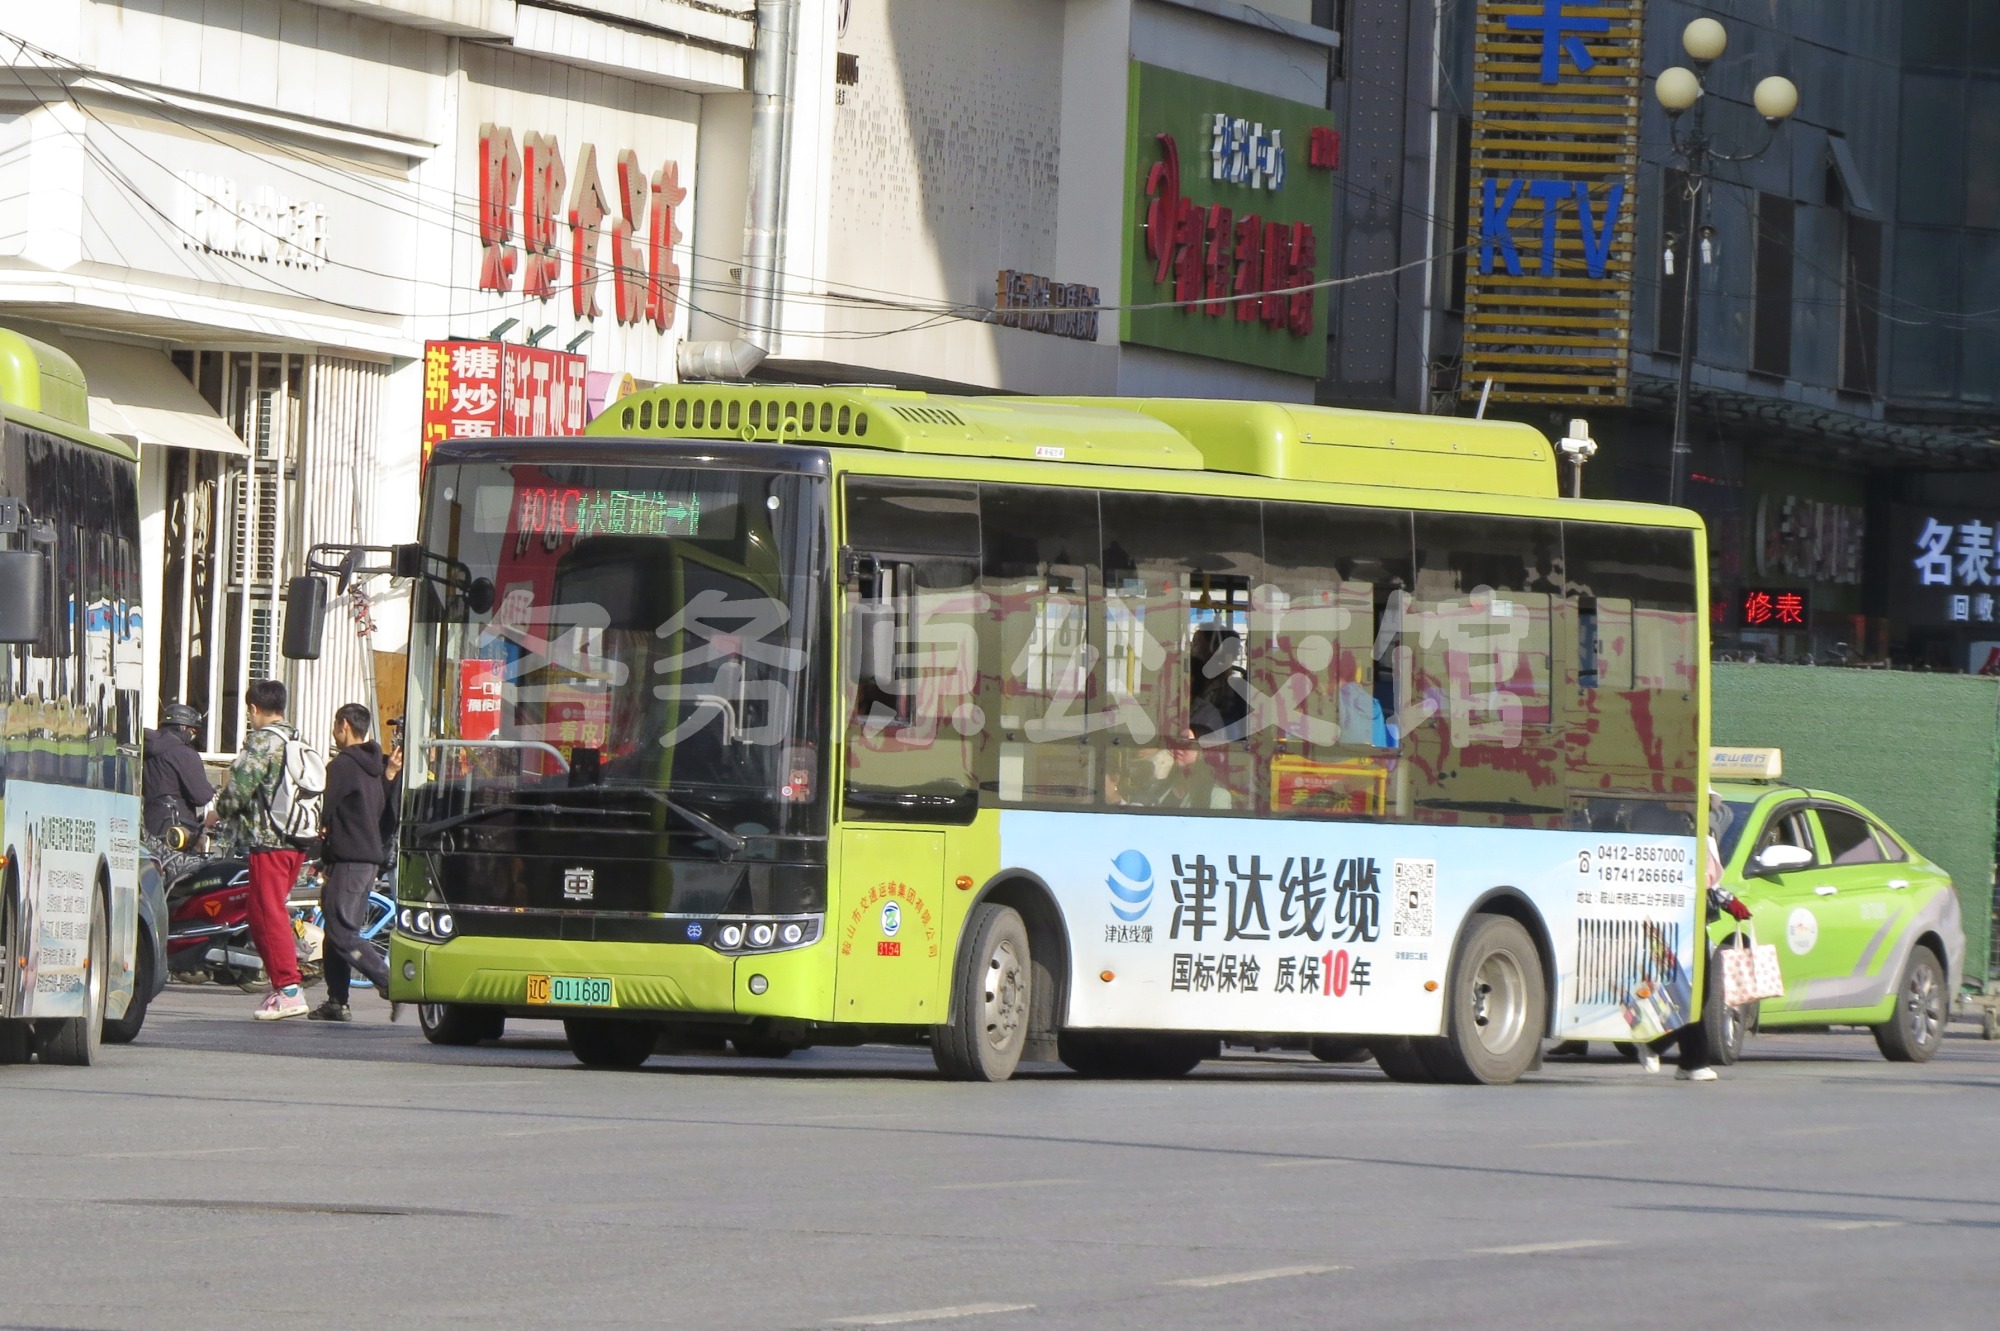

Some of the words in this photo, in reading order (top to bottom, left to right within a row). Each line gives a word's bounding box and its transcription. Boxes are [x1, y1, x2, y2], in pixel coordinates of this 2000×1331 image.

[1480, 178, 1624, 279] KTV
[1914, 517, 2000, 586] 名表
[1746, 591, 1802, 623] 修表
[1598, 845, 1685, 862] 0412-8587000
[1598, 867, 1683, 883] 18741266664
[1169, 854, 1381, 943] 津达线缆
[842, 880, 938, 958] 鞍山市交通运输集团有限公司
[1105, 925, 1153, 943] 津达线缆
[878, 943, 900, 955] 3154
[1170, 953, 1261, 993] 国标保检
[1274, 950, 1371, 997] 质保10年
